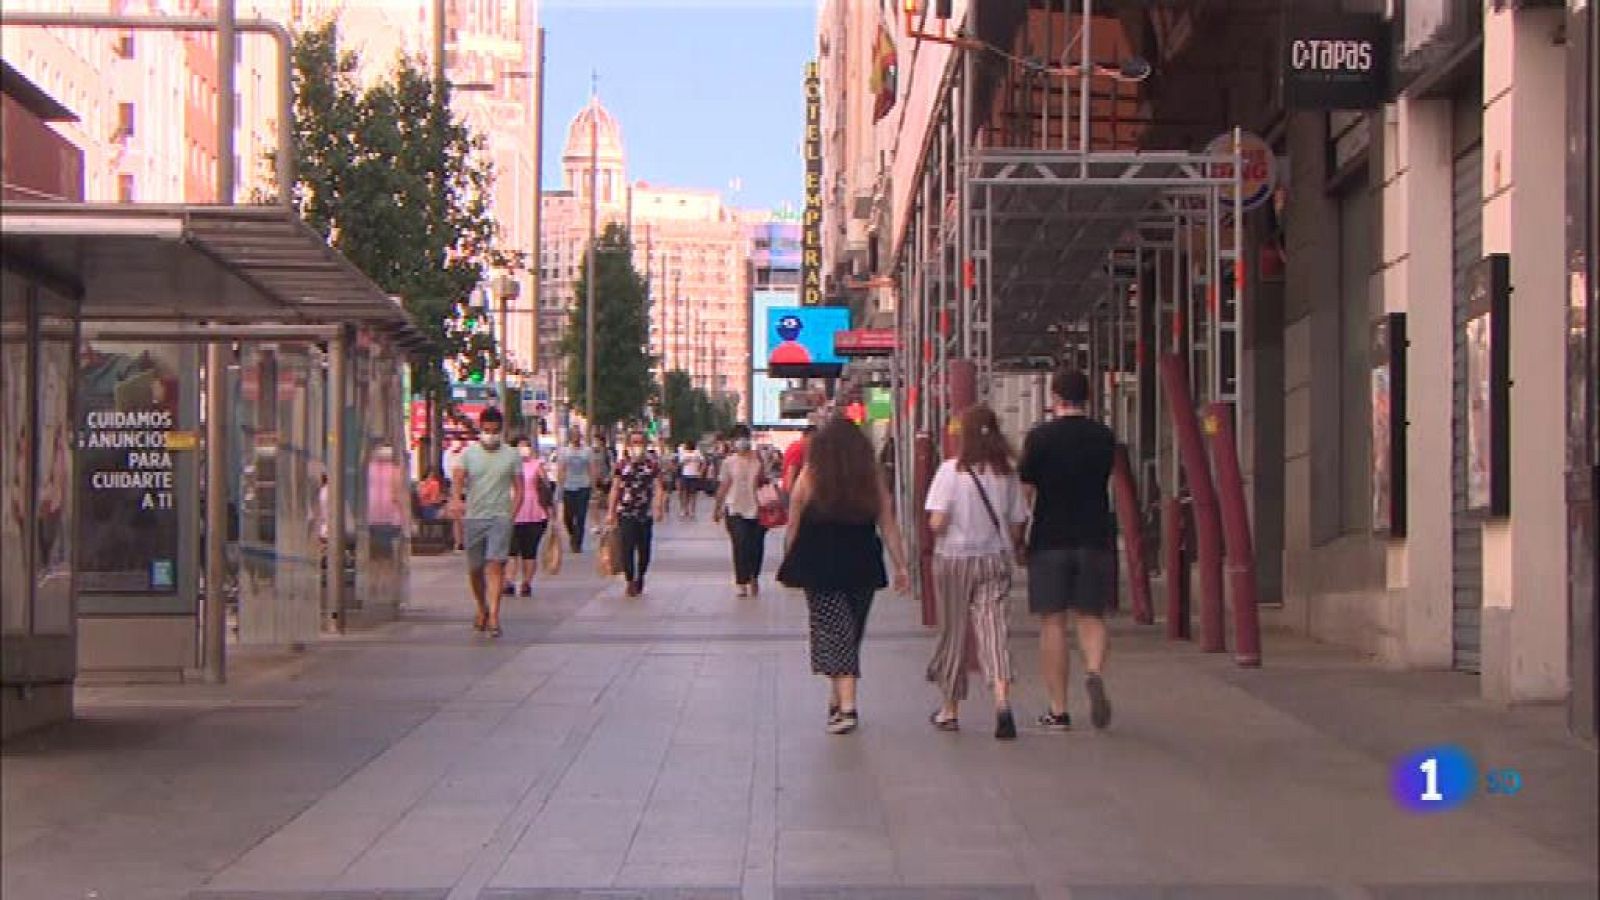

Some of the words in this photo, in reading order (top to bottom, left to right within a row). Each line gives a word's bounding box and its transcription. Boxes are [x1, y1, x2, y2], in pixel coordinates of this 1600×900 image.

[805, 61, 820, 160] HOTEL
[87, 411, 173, 429] CUIDAMOS
[127, 452, 173, 468] PARA
[93, 471, 173, 488] CUIDARTE
[141, 492, 154, 510] A
[158, 492, 173, 510] TI
